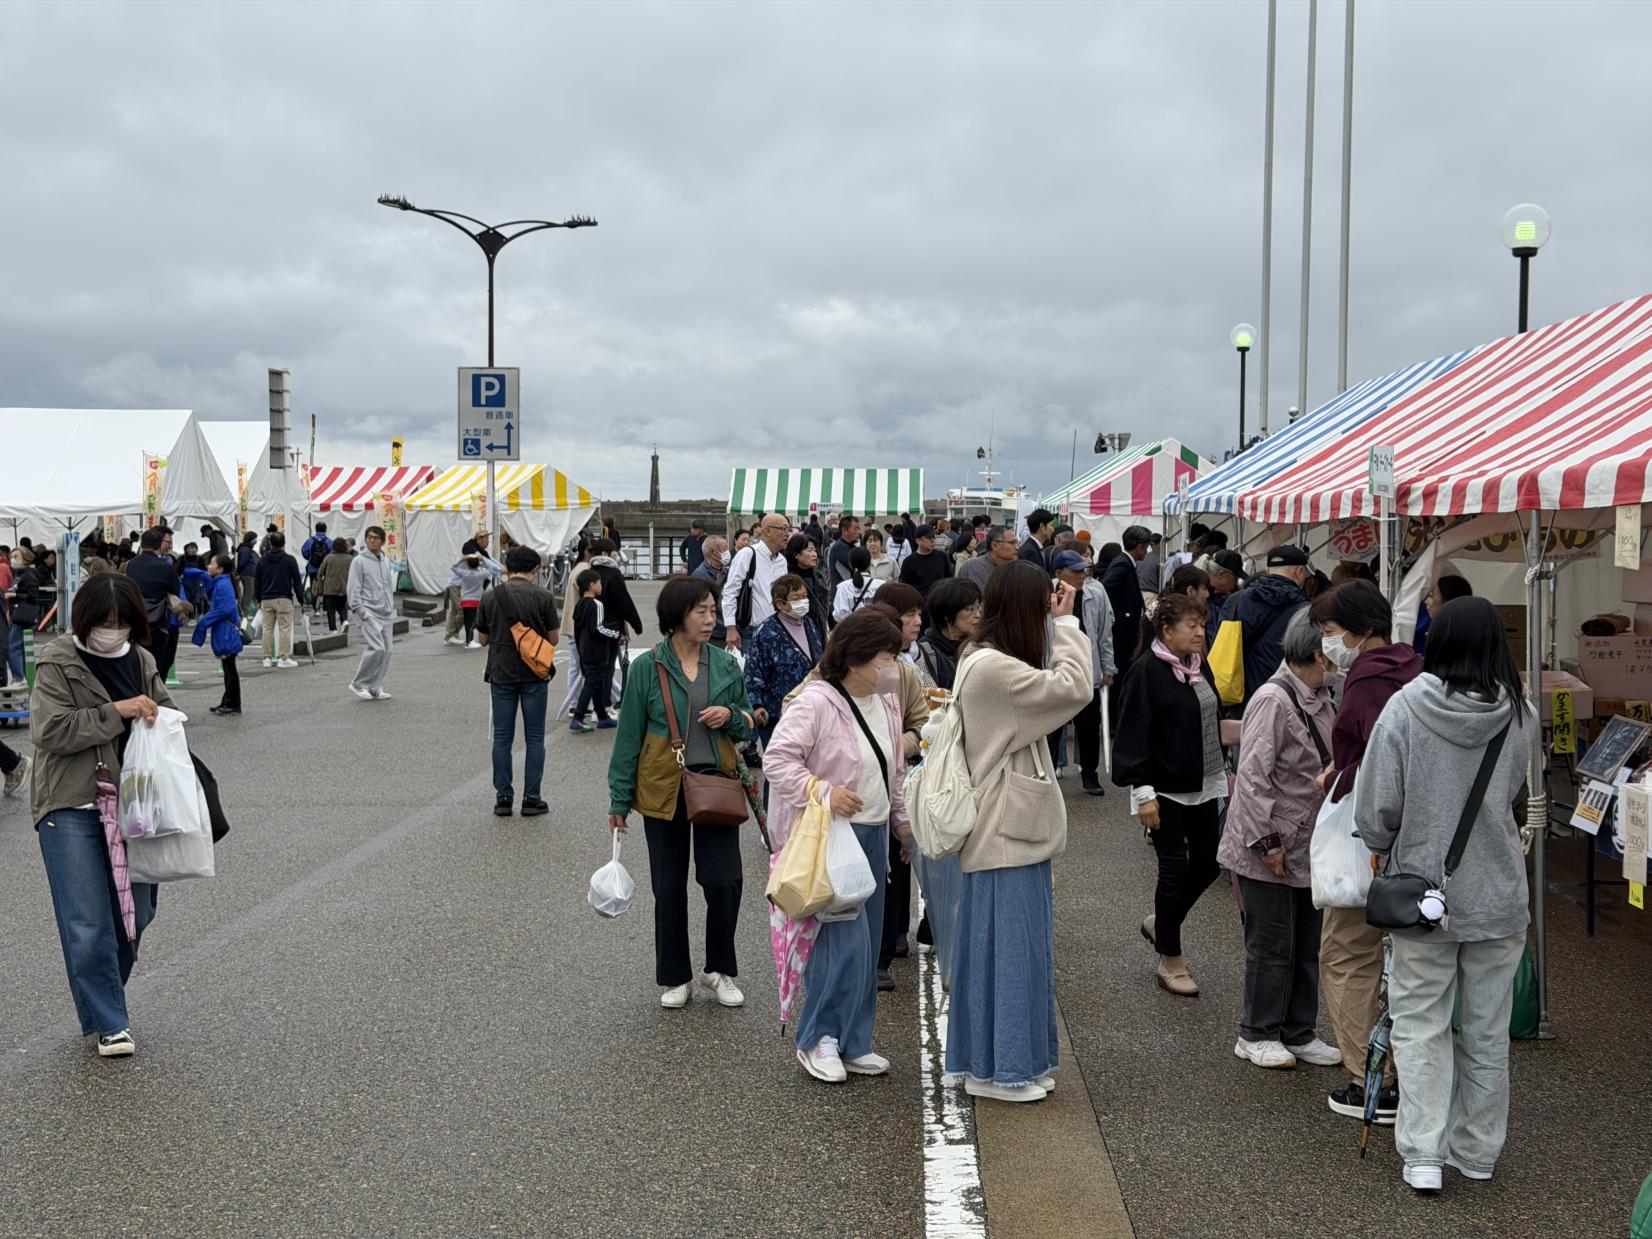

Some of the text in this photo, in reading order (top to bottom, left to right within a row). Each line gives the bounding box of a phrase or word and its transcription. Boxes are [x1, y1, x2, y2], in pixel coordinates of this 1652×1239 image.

[480, 376, 501, 405] P
[486, 411, 514, 420] 普通車
[463, 428, 491, 437] 大型車
